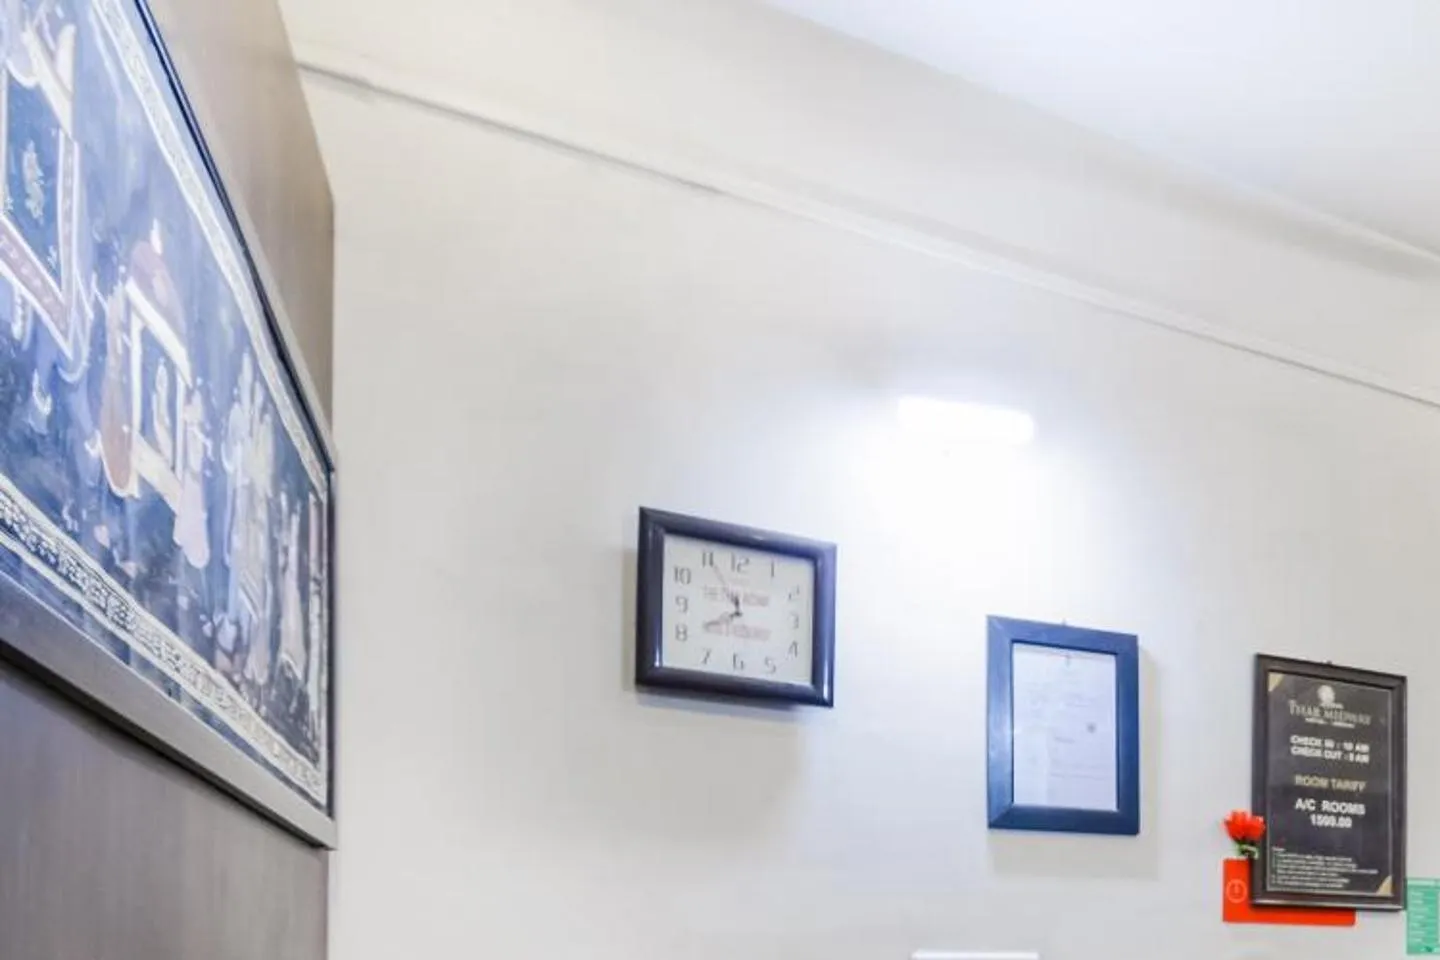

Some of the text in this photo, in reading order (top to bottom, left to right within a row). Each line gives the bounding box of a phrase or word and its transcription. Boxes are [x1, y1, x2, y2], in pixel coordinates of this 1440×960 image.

[702, 552, 714, 568] 11
[730, 553, 750, 573] 12
[673, 566, 692, 585] 10
[675, 596, 800, 630] 9 3
[675, 624, 688, 641] 8
[786, 641, 798, 658] 4
[701, 649, 776, 674] 7 6 5
[1290, 734, 1321, 747] CHECK
[1290, 746, 1321, 758] CHECK
[1324, 749, 1342, 760] OUT
[1295, 774, 1367, 793] ROOM TARIFF
[1295, 798, 1366, 816] A/C ROOMS
